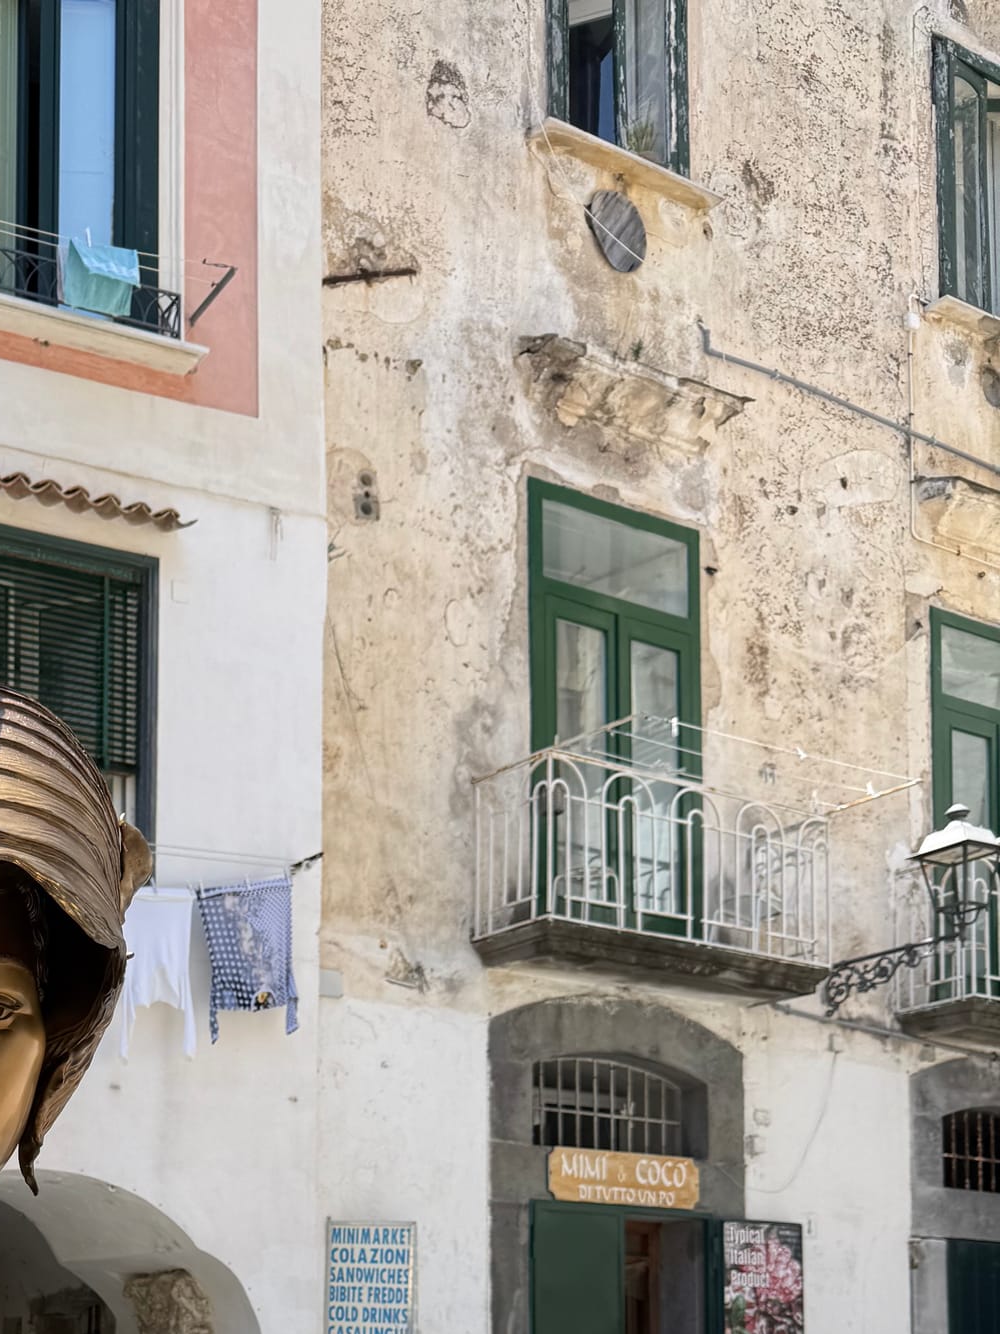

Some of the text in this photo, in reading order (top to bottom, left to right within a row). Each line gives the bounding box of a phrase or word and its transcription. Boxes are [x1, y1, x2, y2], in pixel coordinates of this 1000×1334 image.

[579, 1184, 592, 1200] DI
[729, 1225, 764, 1244] Typical
[330, 1248, 410, 1265] COLAZIONI
[730, 1247, 765, 1265] Italian
[329, 1267, 409, 1284] SANDWICHES
[328, 1286, 408, 1304] BIBITE FREDDE
[328, 1306, 408, 1324] COLD DRINKS
